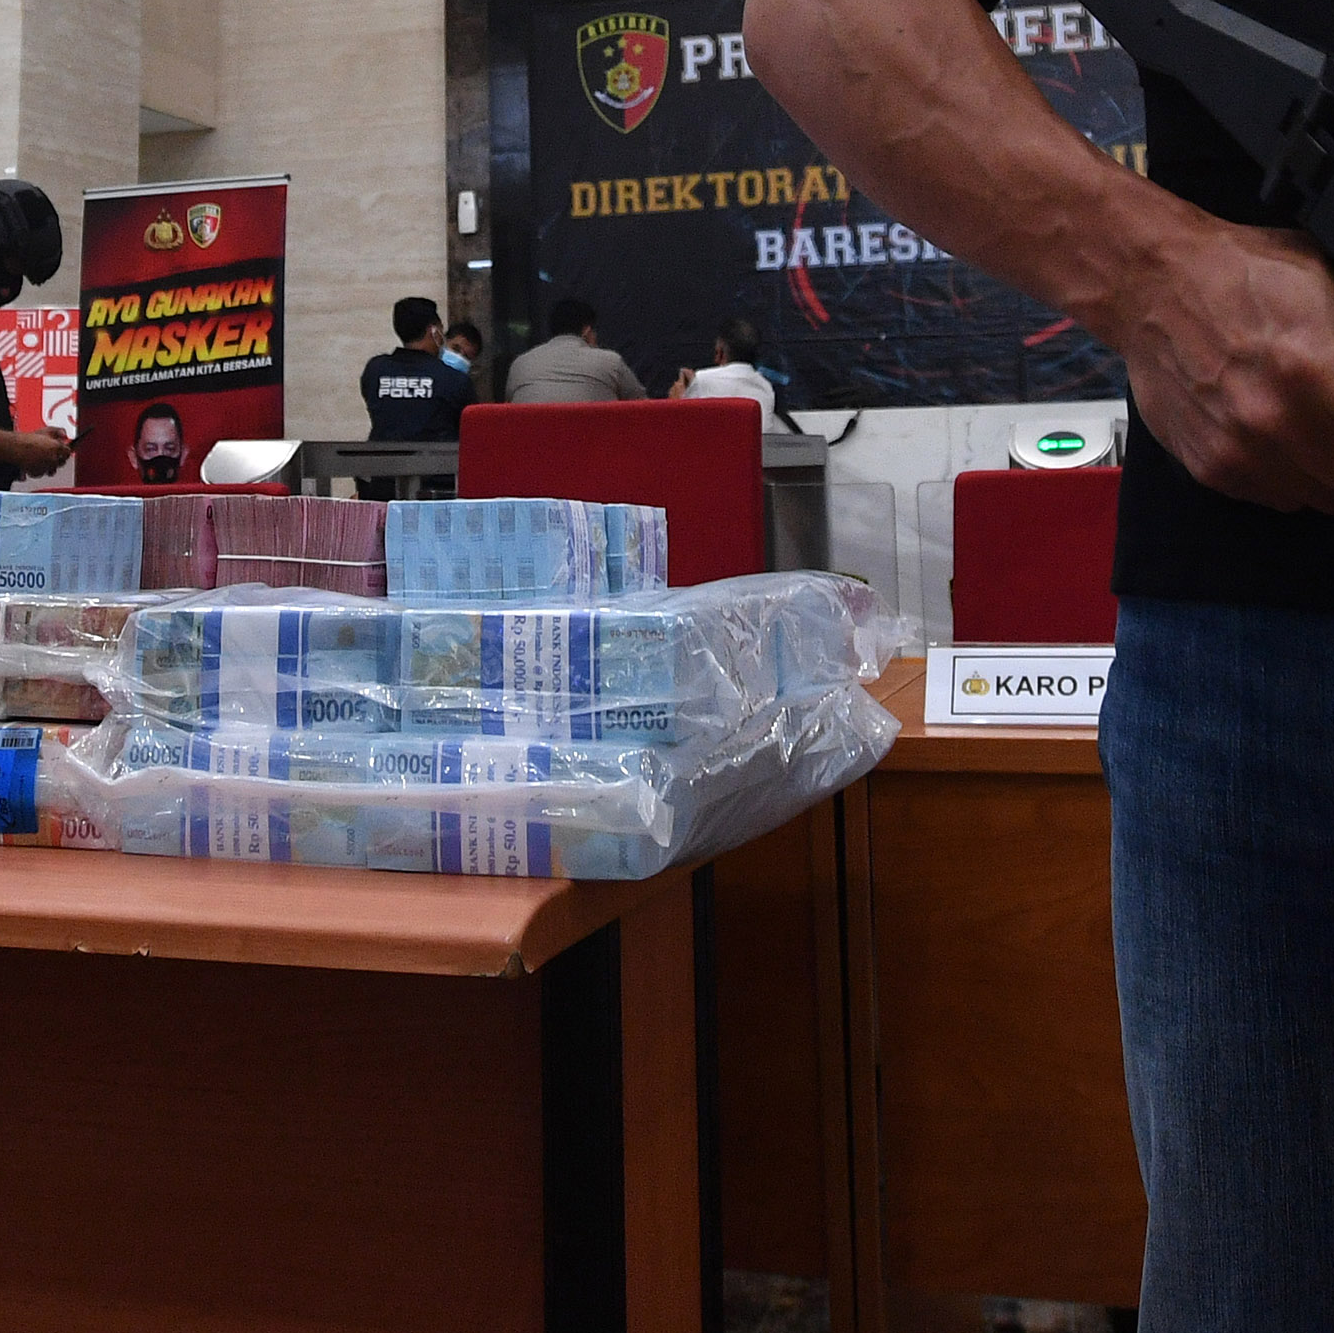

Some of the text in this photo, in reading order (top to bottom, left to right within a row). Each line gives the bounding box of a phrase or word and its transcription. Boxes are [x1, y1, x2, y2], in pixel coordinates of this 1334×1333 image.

[85, 275, 276, 328] AYO GUNAKAN
[85, 310, 274, 377] MASKER
[85, 356, 273, 390] UNTUK KESELAMATAN KITA BERSAMA
[378, 375, 434, 388] SIBER
[378, 388, 434, 399] POLRI
[510, 615, 526, 635] Rp
[551, 616, 562, 651] BANK
[995, 675, 1078, 696] KARO
[603, 710, 668, 731] 50000
[129, 744, 182, 765] 50000
[372, 753, 432, 768] 50000
[215, 818, 225, 852] BANK
[504, 855, 520, 876] Rp
